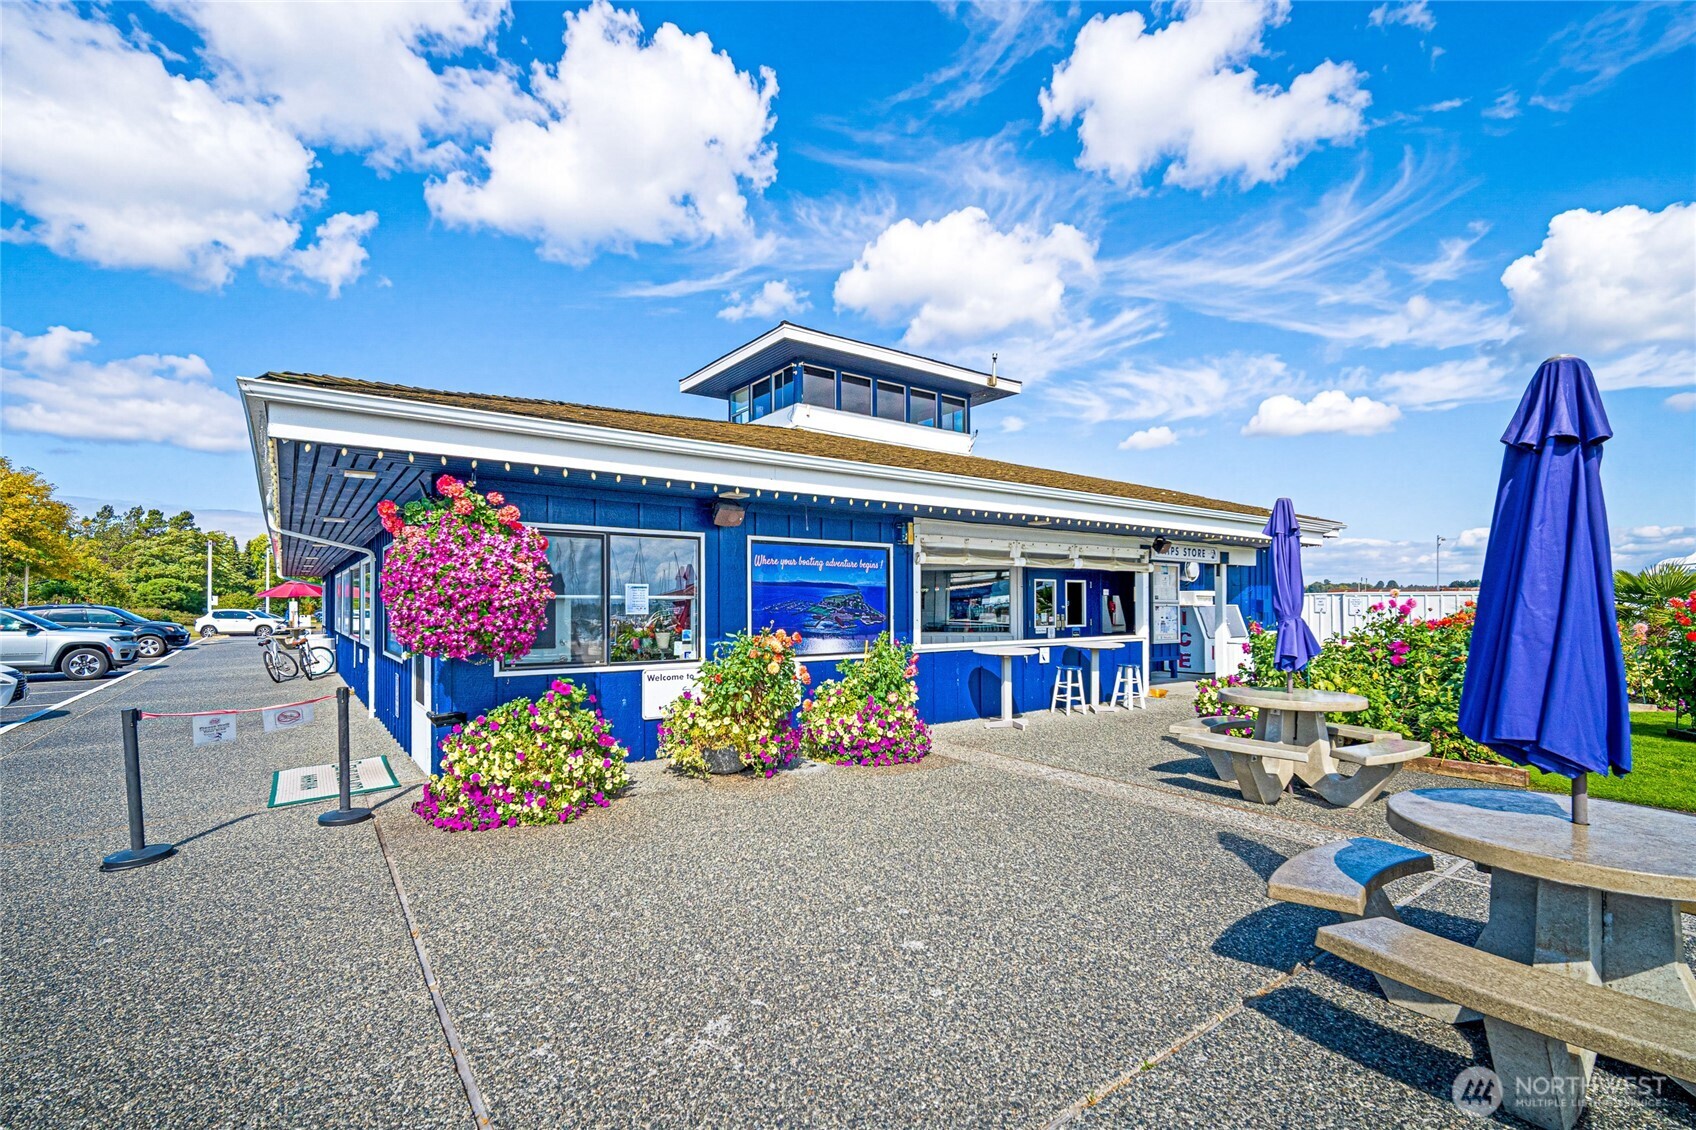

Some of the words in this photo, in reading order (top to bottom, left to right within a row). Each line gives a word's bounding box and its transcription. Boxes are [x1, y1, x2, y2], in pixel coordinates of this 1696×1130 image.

[1183, 547, 1206, 558] STORE
[754, 554, 779, 567] Where
[780, 559, 797, 570] your
[798, 556, 824, 571] boating
[825, 558, 858, 568] adventure
[859, 560, 879, 573] begins
[1178, 611, 1192, 669] ICE
[647, 674, 684, 682] Welcome
